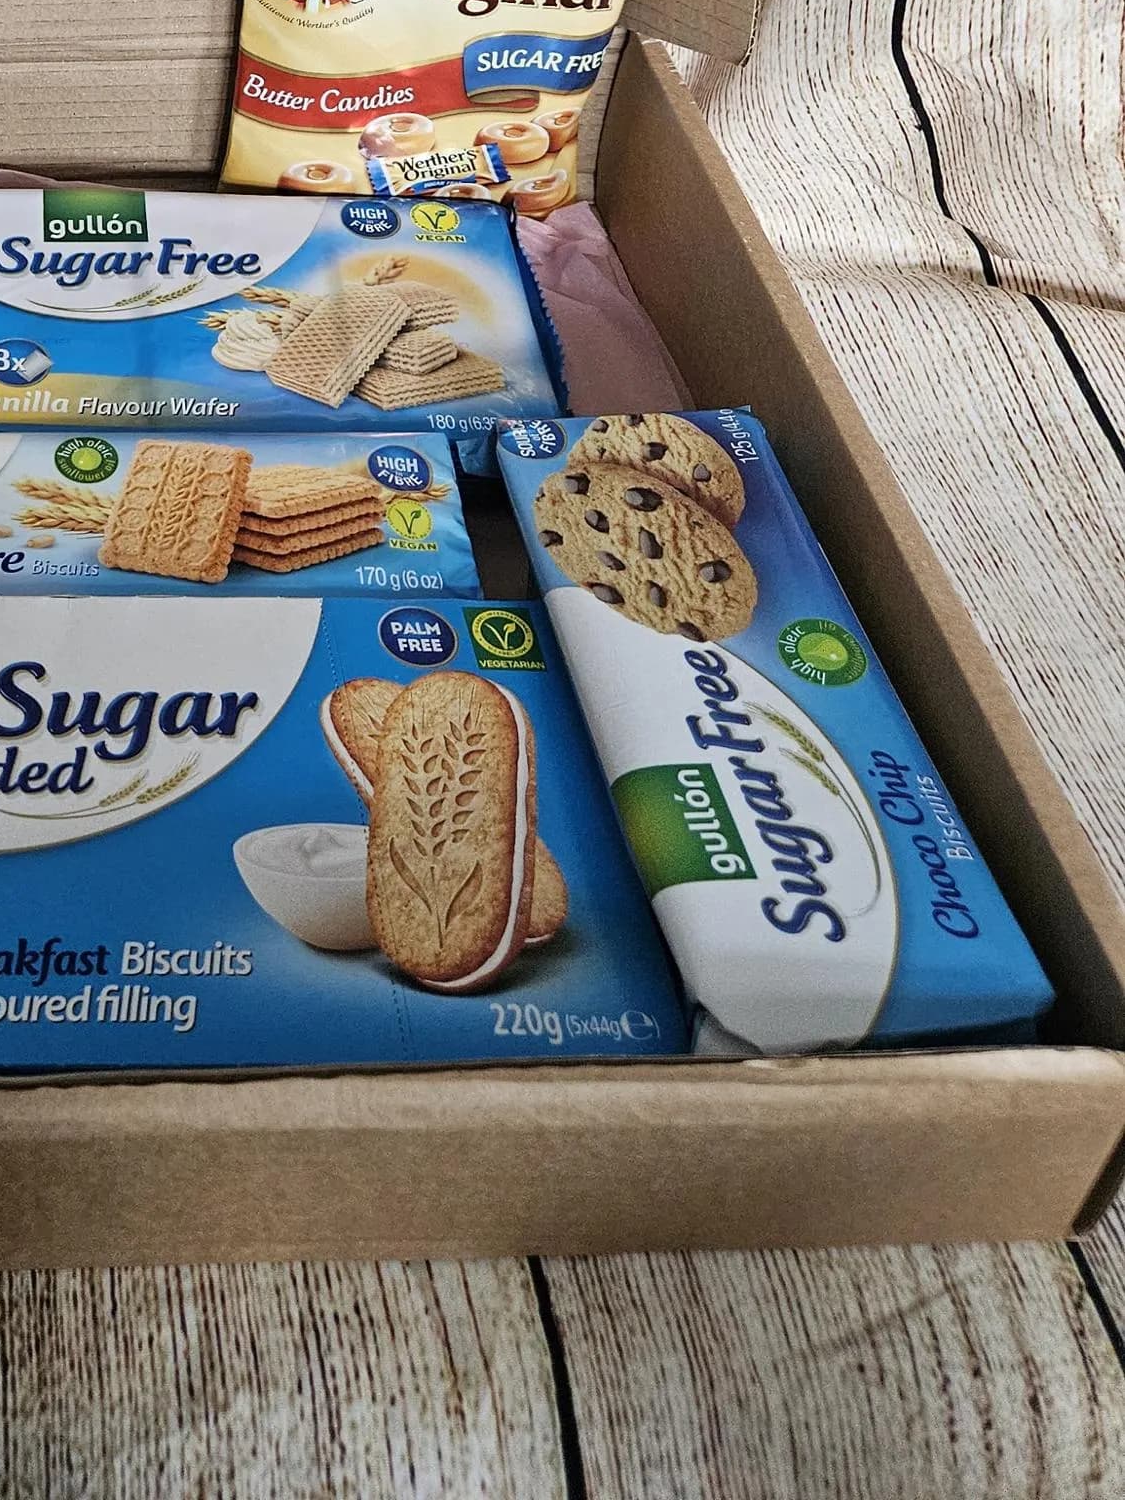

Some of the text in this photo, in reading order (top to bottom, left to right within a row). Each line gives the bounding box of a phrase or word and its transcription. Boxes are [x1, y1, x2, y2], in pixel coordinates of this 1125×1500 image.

[295, 17, 340, 30] Werther's
[341, 6, 375, 26] Quality
[477, 49, 563, 72] SUGAR
[243, 73, 415, 113] Butter Candies
[391, 148, 478, 173] Werther's
[403, 160, 478, 182] Original
[349, 207, 388, 220] HIGH
[48, 211, 144, 240] gullón
[349, 219, 393, 233] FIBRE
[415, 234, 466, 242] VEGAN
[154, 238, 261, 277] Free
[77, 397, 167, 418] Flavour
[170, 398, 240, 419] Wafer
[427, 414, 456, 430] 180
[56, 438, 114, 459] high oleic
[529, 419, 557, 455] FIBRE
[731, 440, 760, 464] 125
[376, 455, 419, 473] HIGH
[377, 469, 424, 487] FIBRE
[389, 539, 437, 550] VEGAN
[31, 557, 101, 578] Biscuits
[355, 566, 387, 586] 170
[391, 621, 442, 636] PALM
[397, 637, 444, 653] FREE
[778, 625, 827, 685] high oleic
[478, 659, 546, 669] VEGETARIAN
[685, 647, 847, 944] Sugar Free
[676, 766, 748, 875] gullón
[918, 773, 972, 863] Biscuits
[870, 750, 980, 940] Choco Chip
[120, 940, 252, 977] Biscuits
[95, 984, 197, 1031] filling
[489, 1002, 564, 1045] 220g
